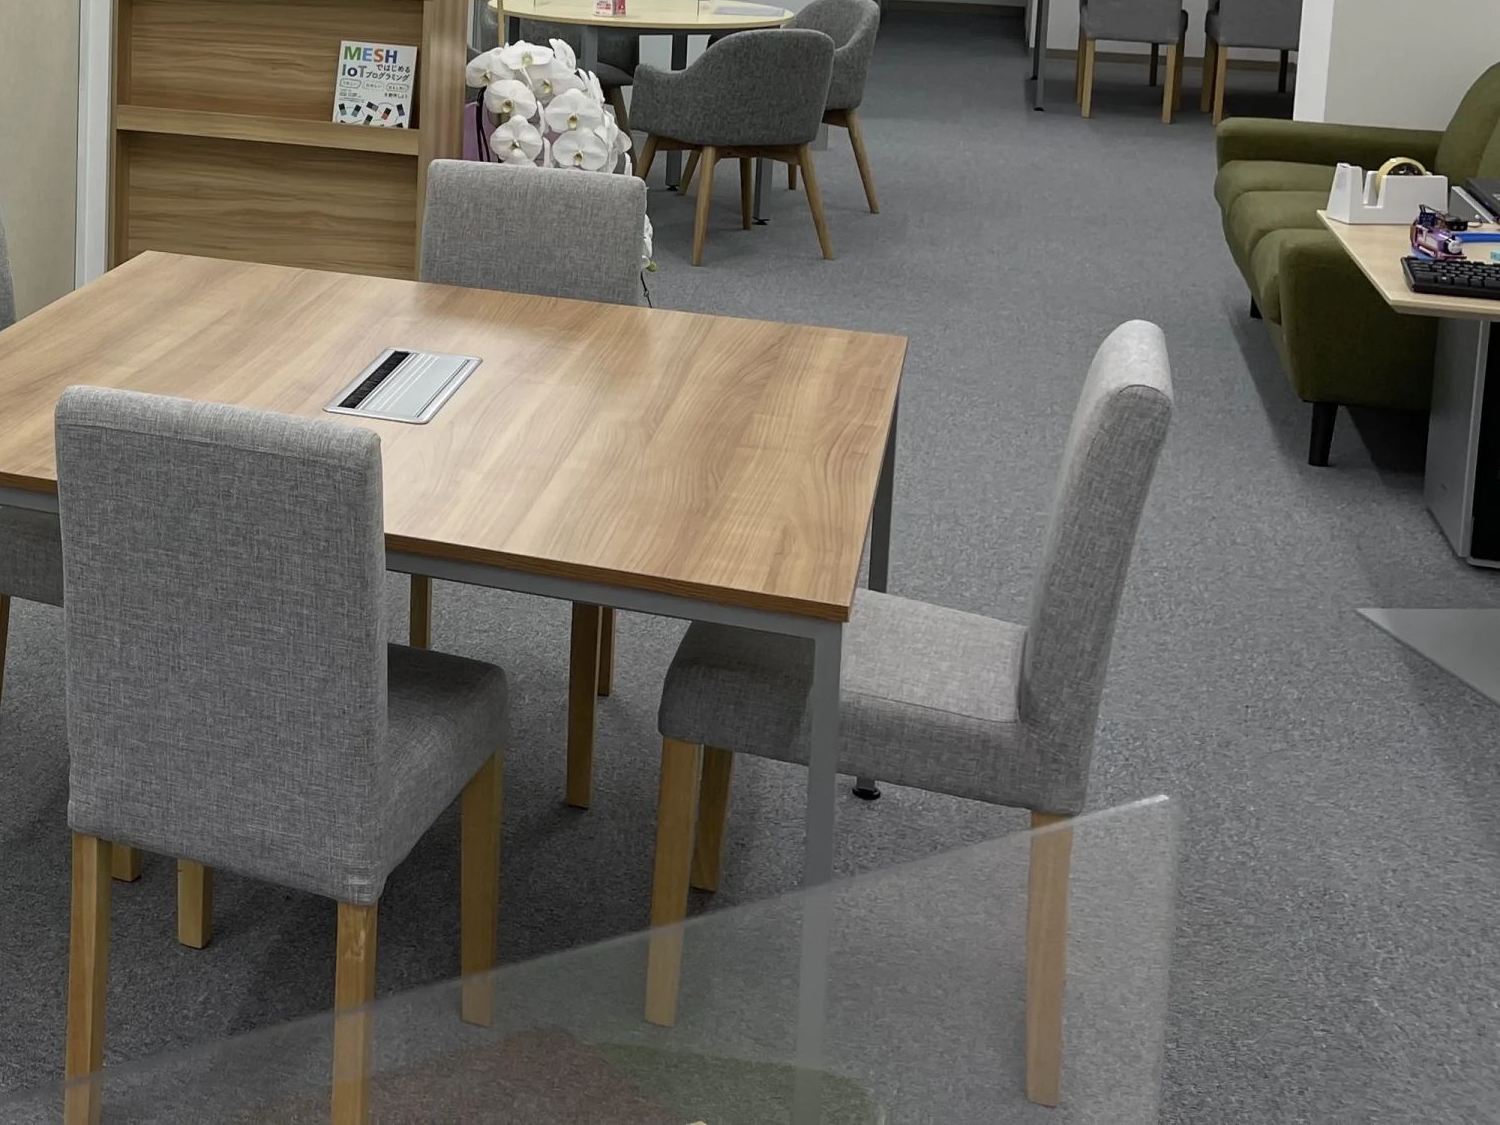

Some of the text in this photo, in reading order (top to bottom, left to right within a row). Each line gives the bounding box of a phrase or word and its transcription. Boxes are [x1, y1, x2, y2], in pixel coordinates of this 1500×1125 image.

[343, 46, 398, 64] MESH
[377, 64, 411, 73] ではじめる
